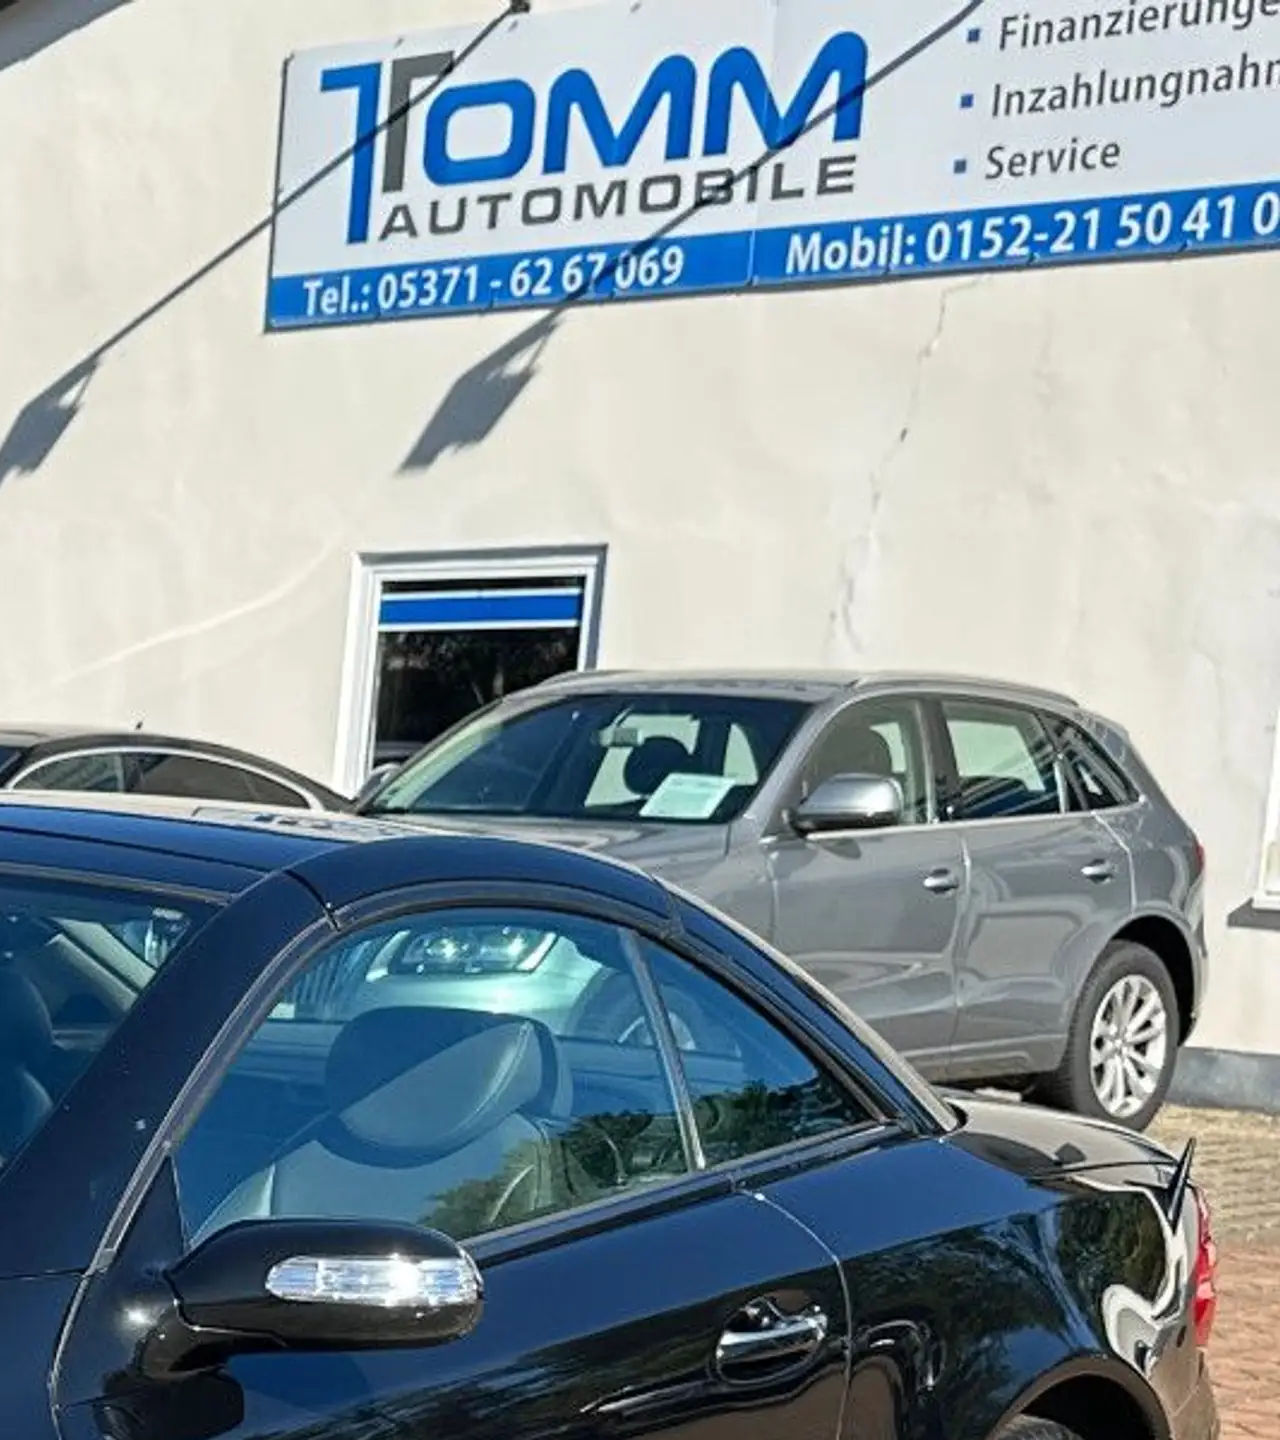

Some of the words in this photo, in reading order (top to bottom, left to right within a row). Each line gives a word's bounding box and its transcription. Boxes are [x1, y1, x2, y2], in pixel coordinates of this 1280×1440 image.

[319, 31, 868, 245] TOMM
[985, 137, 1121, 180] Service
[379, 155, 857, 241] AUTOMOBILE
[786, 221, 918, 275] Mobil:
[926, 207, 1101, 262] 0152-21
[1115, 201, 1172, 248] 50
[1182, 194, 1236, 241] 41
[303, 279, 372, 316] Tel.:
[377, 264, 479, 309] 05371
[510, 260, 552, 298] 62
[562, 252, 608, 292] 67
[613, 245, 684, 290] 069
